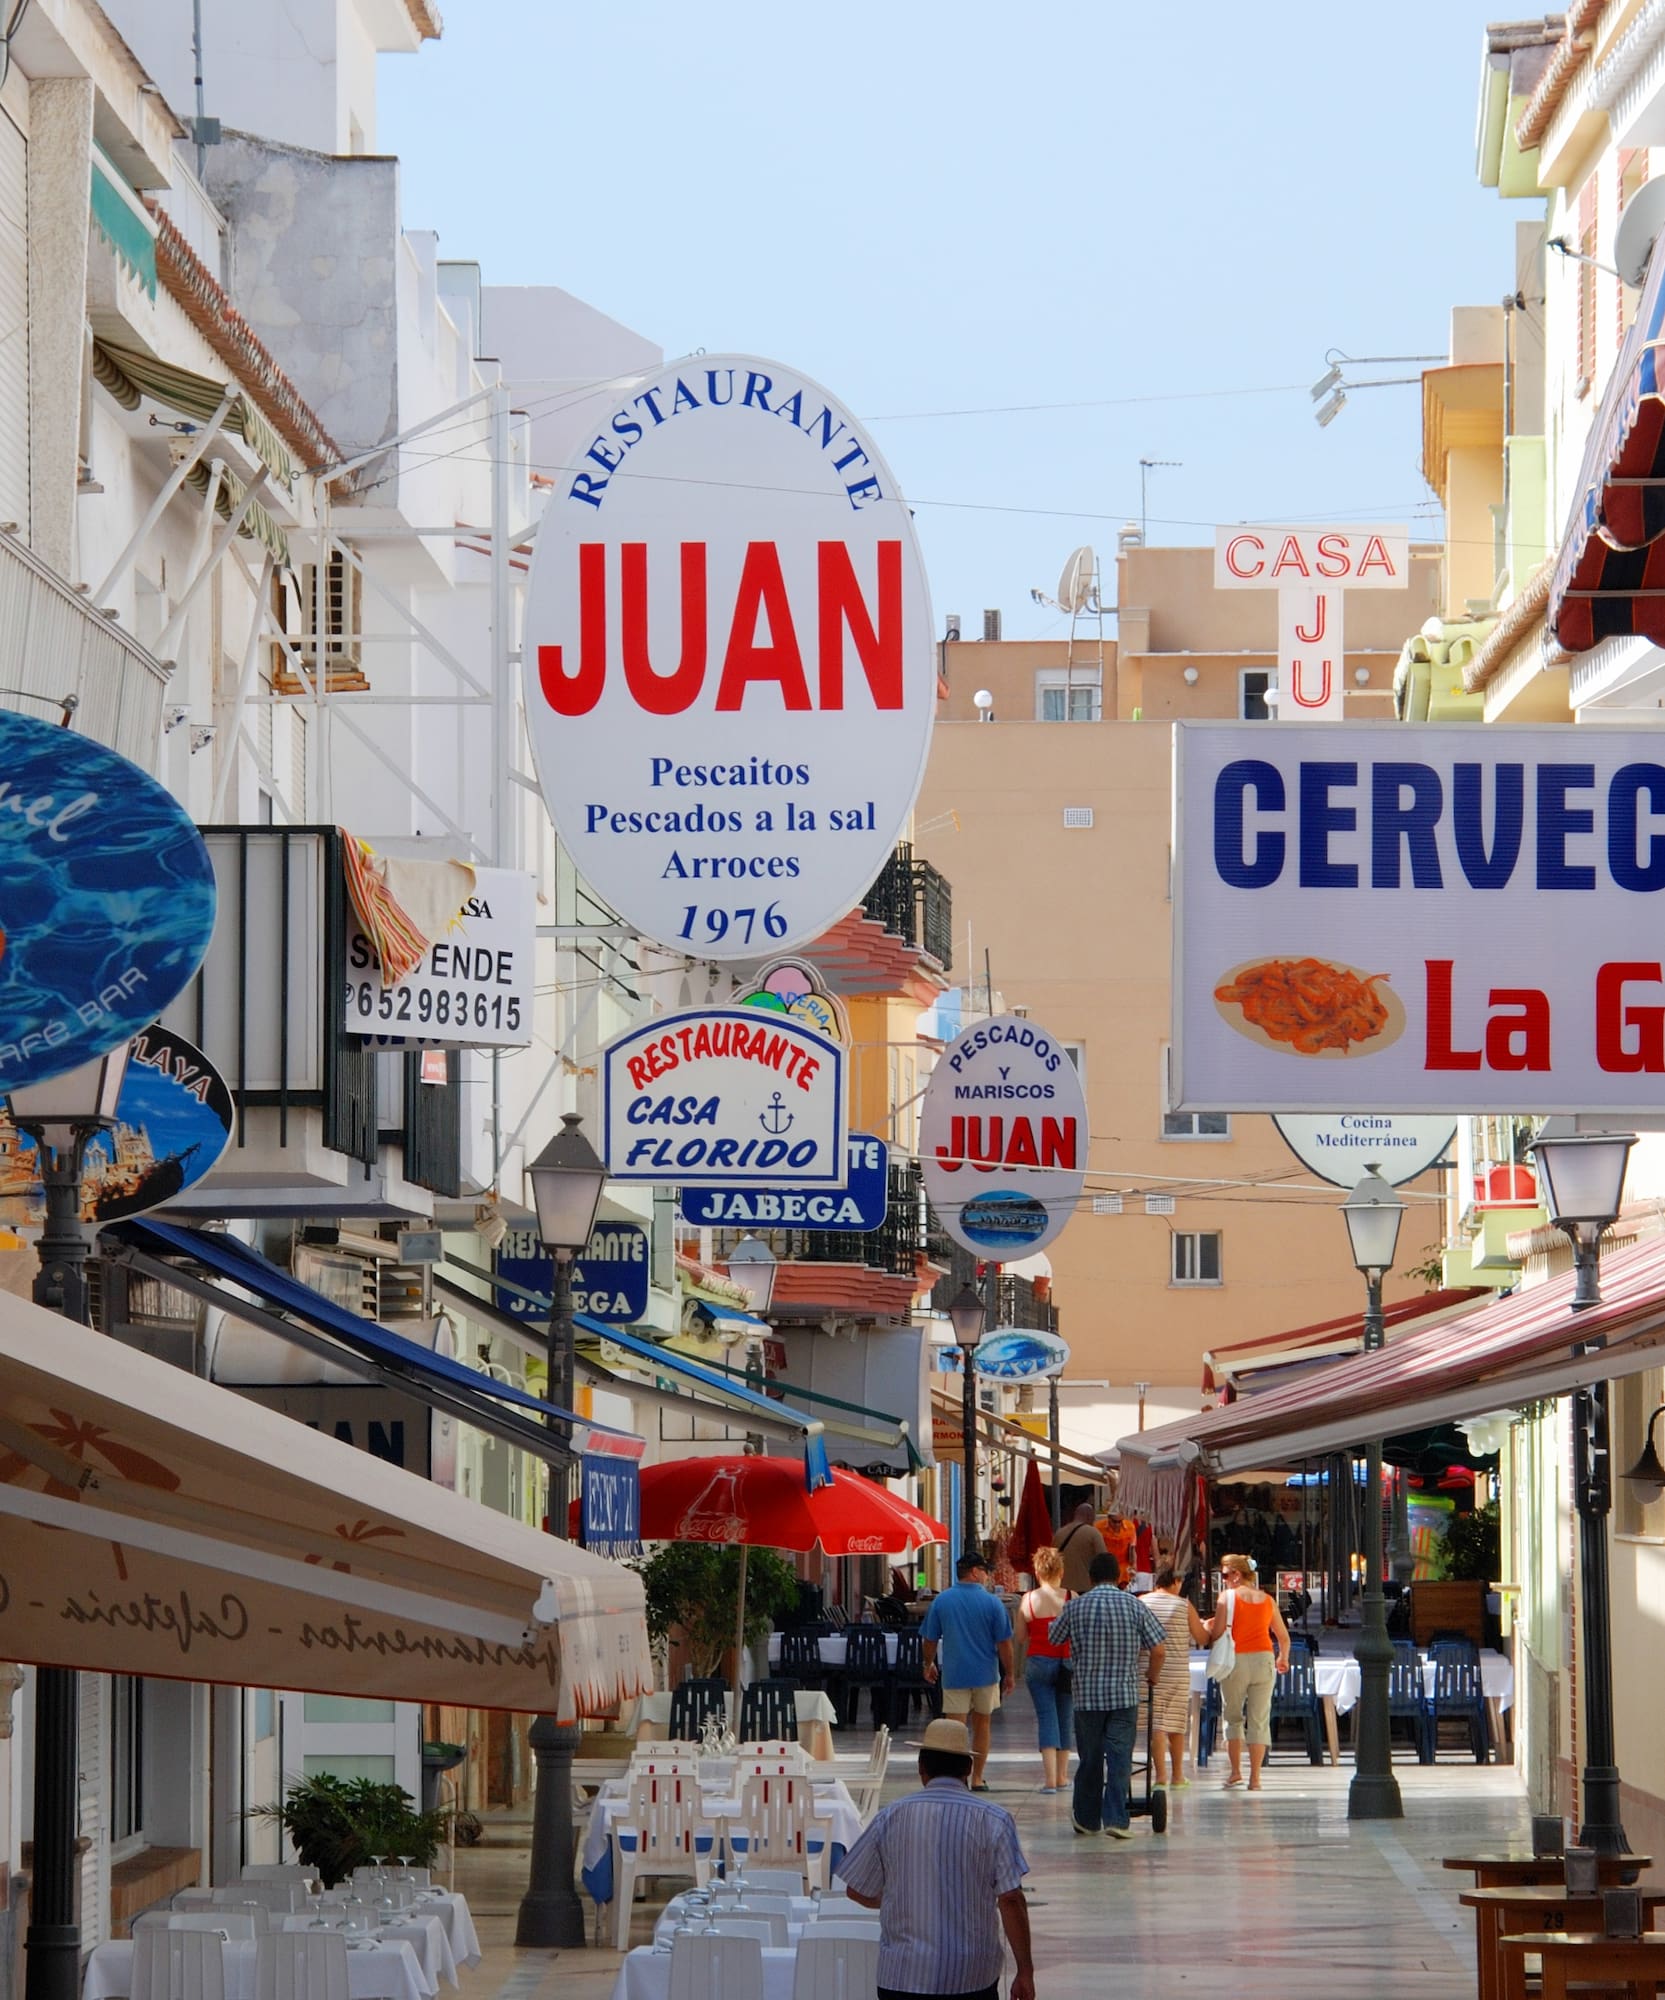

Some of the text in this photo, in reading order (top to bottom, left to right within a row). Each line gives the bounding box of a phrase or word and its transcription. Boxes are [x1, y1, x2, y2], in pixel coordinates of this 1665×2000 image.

[568, 369, 884, 511] RESTAURANTE
[1226, 534, 1397, 578] CASA
[538, 540, 904, 717] JUAN
[650, 757, 810, 787] Pescaitos
[584, 802, 876, 833] Pescados a la sal
[1213, 759, 1665, 892] CERVEC
[661, 850, 800, 879] Arroces
[461, 897, 493, 919] SA
[676, 901, 788, 944] 1976
[413, 943, 513, 985] ENDE
[76, 966, 148, 1028] BAR
[357, 982, 521, 1031] 652983615
[1424, 960, 1552, 1071] La
[626, 1022, 821, 1092] RESTAURANTE
[948, 1025, 1061, 1073] PESCADOS
[955, 1084, 1055, 1100] MARISCOS
[998, 1066, 1011, 1081] Y
[626, 1096, 721, 1125] CASA
[1340, 1115, 1392, 1129] Cocina
[625, 1138, 818, 1169] FLORIDO
[935, 1116, 1078, 1173] JUAN
[1315, 1133, 1417, 1147] Mediterránea
[701, 1193, 865, 1224] JABEGA
